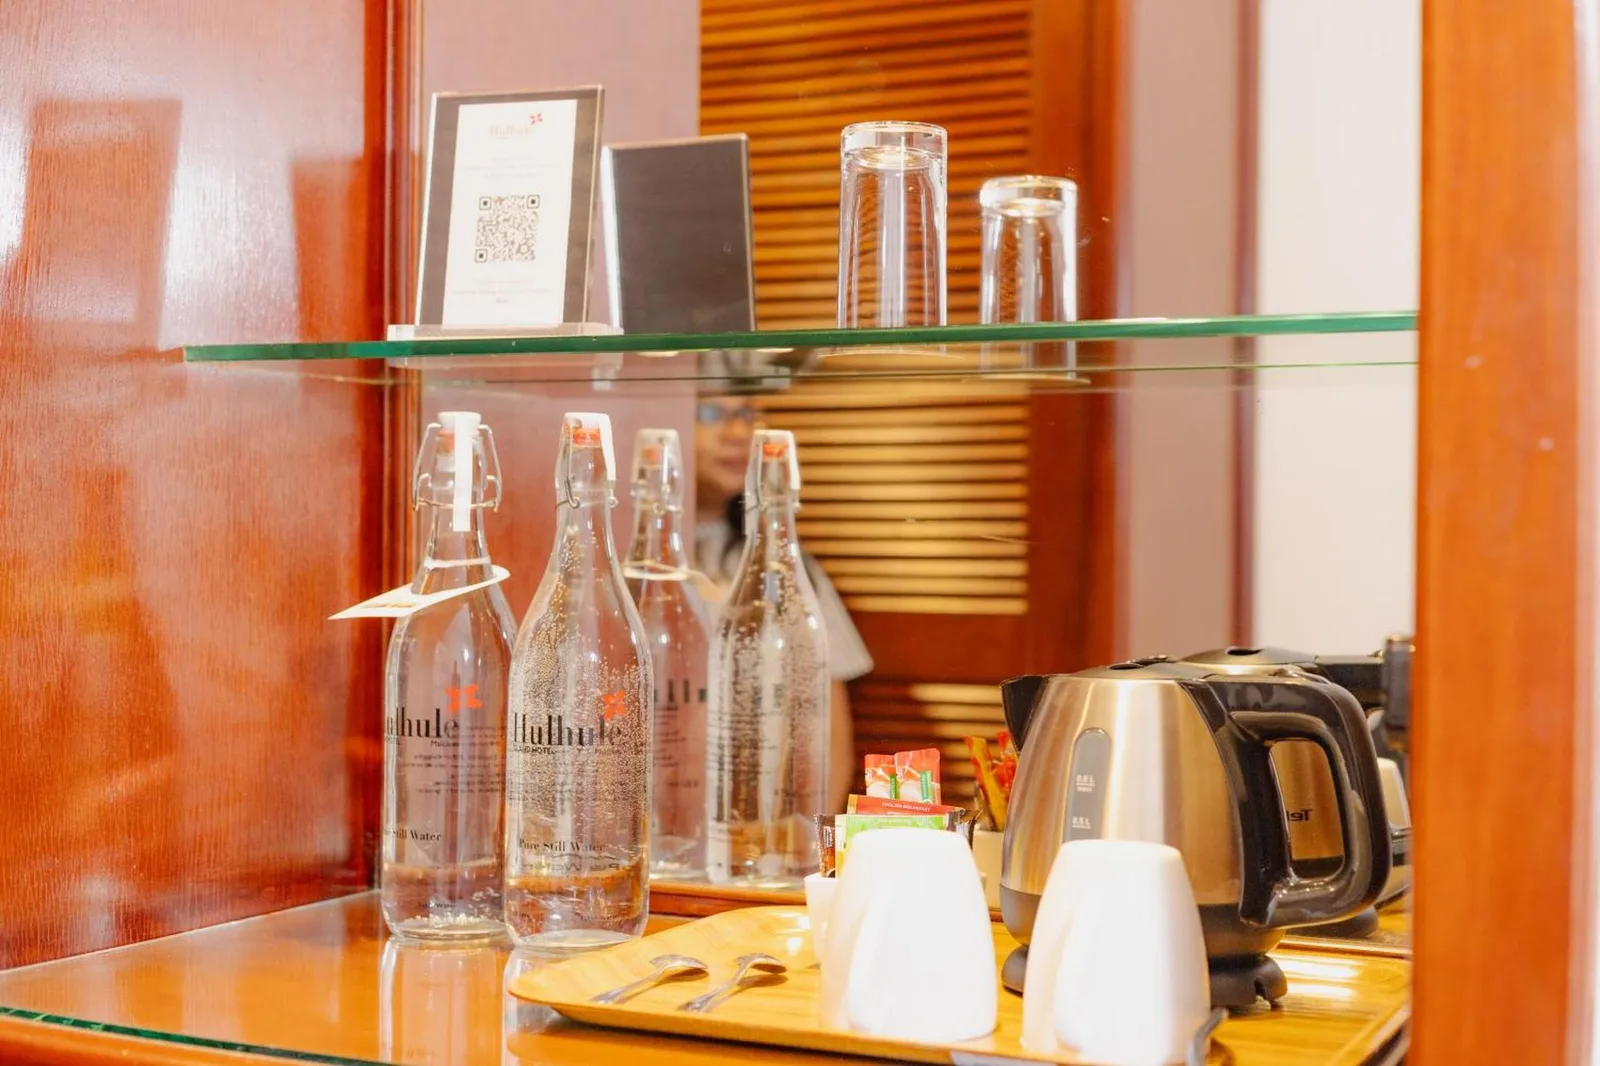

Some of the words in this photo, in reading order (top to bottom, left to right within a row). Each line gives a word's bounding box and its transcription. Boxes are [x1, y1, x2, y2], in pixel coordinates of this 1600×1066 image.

[386, 706, 460, 739] ulhule
[513, 711, 623, 748] Hulhule
[409, 829, 442, 842] Water
[543, 840, 566, 852] Still
